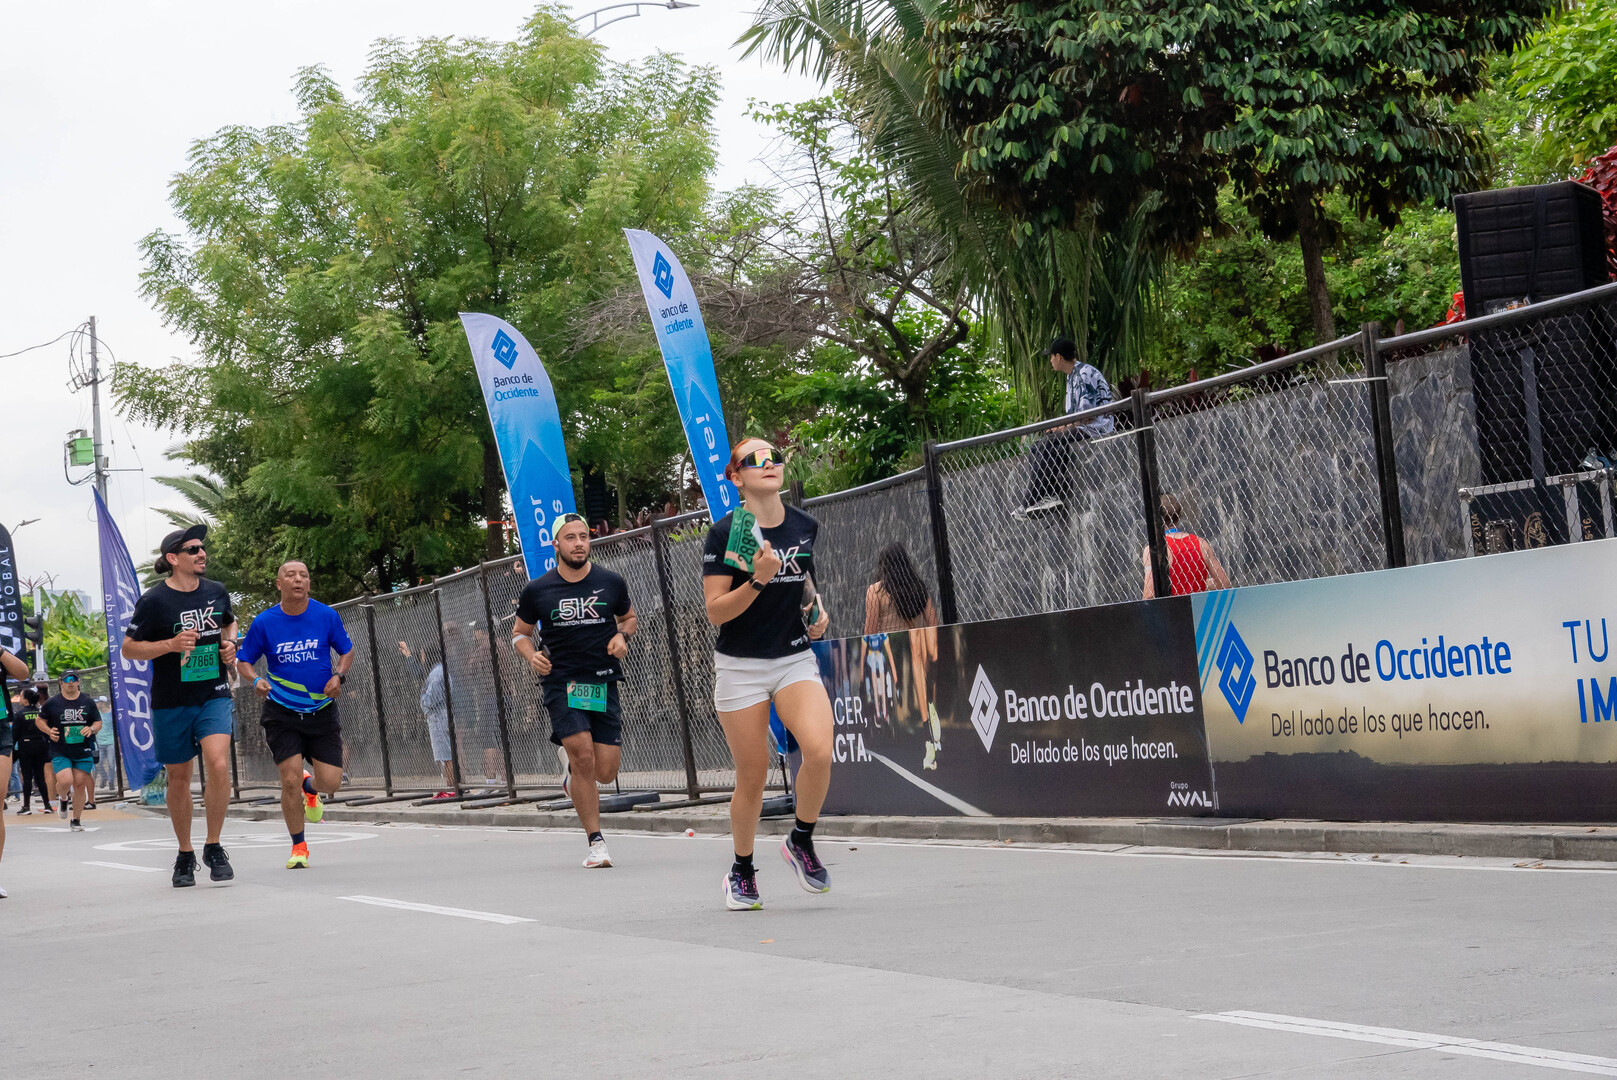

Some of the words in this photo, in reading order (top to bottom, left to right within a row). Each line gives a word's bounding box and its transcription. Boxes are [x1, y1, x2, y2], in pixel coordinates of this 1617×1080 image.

[658, 304, 678, 319] anco
[679, 301, 689, 314] de
[664, 317, 694, 335] ccidente
[493, 374, 521, 388] Banco
[522, 372, 534, 384] de
[494, 387, 539, 402] Occidente
[530, 494, 554, 548] por
[0, 546, 18, 622] GLOBAL
[558, 596, 600, 620] 5K
[179, 606, 218, 632] 5K
[276, 639, 319, 654] TEAM
[1562, 618, 1609, 664] TU
[185, 653, 214, 669] 27865
[277, 650, 319, 664] CRISTAL
[1263, 649, 1335, 688] Banco
[1340, 643, 1370, 683] de
[1375, 635, 1512, 682] Occidente
[571, 684, 601, 699] 25879
[1004, 688, 1060, 723] Banco
[1063, 684, 1087, 717] de
[1090, 679, 1195, 719] Occidente
[64, 708, 84, 721] 5K
[832, 695, 868, 728] CER,
[1271, 711, 1296, 737] Del
[1299, 709, 1334, 736] lado
[1337, 707, 1358, 734] de
[1362, 706, 1386, 733] los
[1391, 713, 1423, 740] que
[1427, 704, 1490, 731] hacen.
[832, 733, 872, 763] CTA.
[1010, 742, 1030, 764] Del
[1033, 740, 1060, 763] lado
[1062, 739, 1079, 762] de
[1081, 738, 1101, 761] los
[1103, 743, 1129, 766] que
[1131, 738, 1179, 760] hacen.
[1170, 781, 1189, 790] Grupo
[1167, 791, 1213, 808] AVAL
